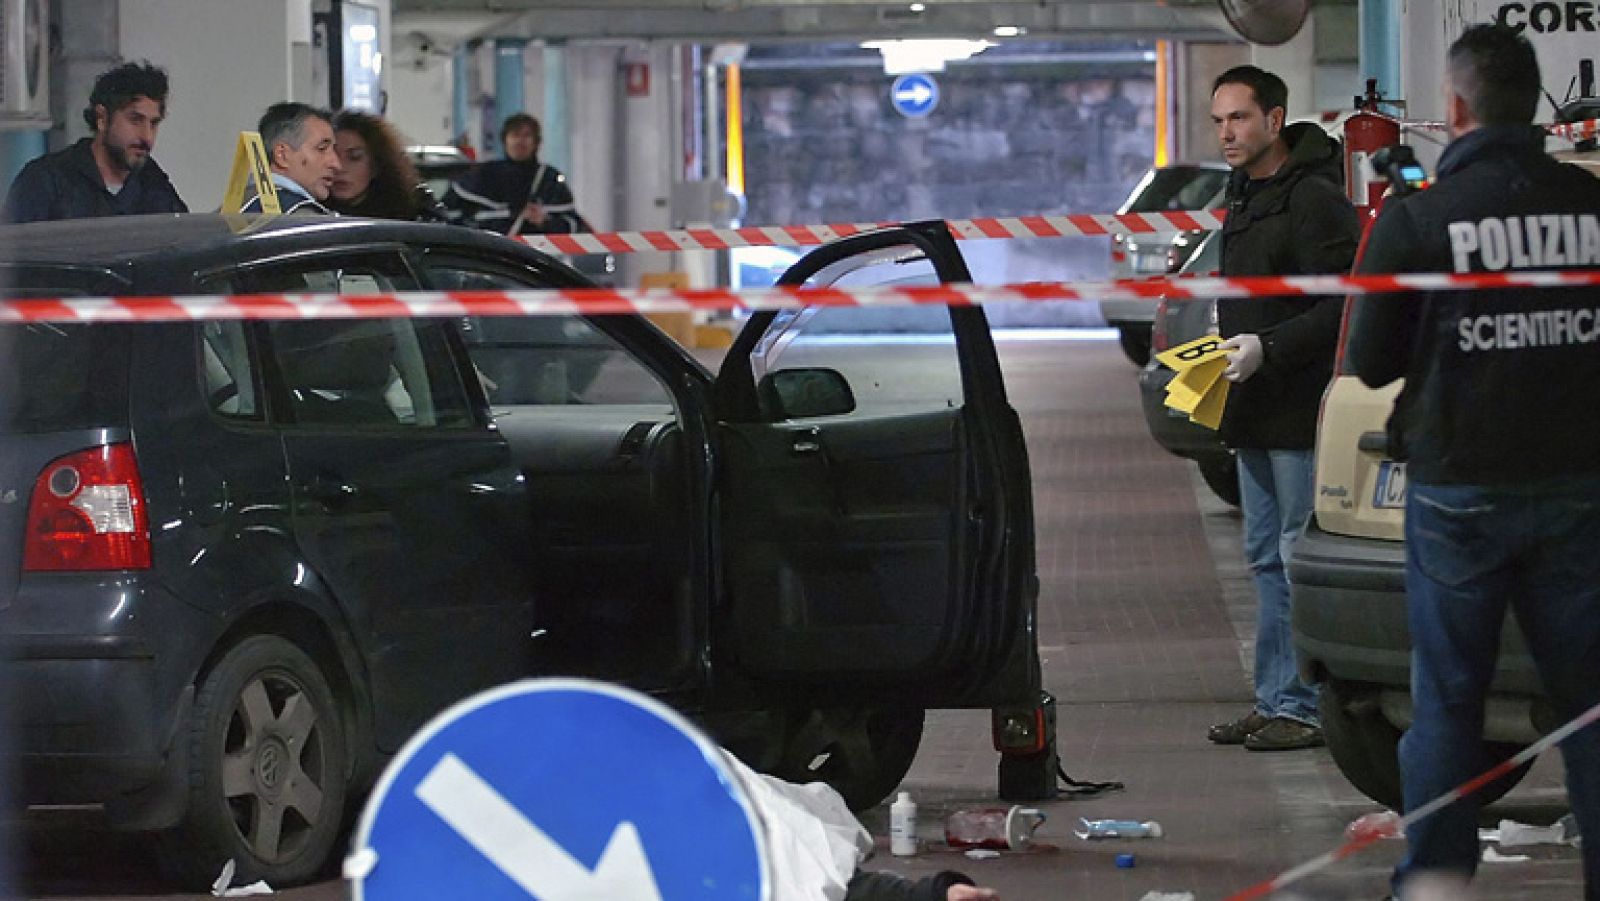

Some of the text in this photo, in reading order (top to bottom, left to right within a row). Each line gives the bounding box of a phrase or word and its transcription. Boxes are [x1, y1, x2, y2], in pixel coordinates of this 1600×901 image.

[1498, 1, 1600, 33] COR
[252, 141, 273, 196] A
[1448, 215, 1600, 272] POLIZIA
[1175, 340, 1219, 361] B
